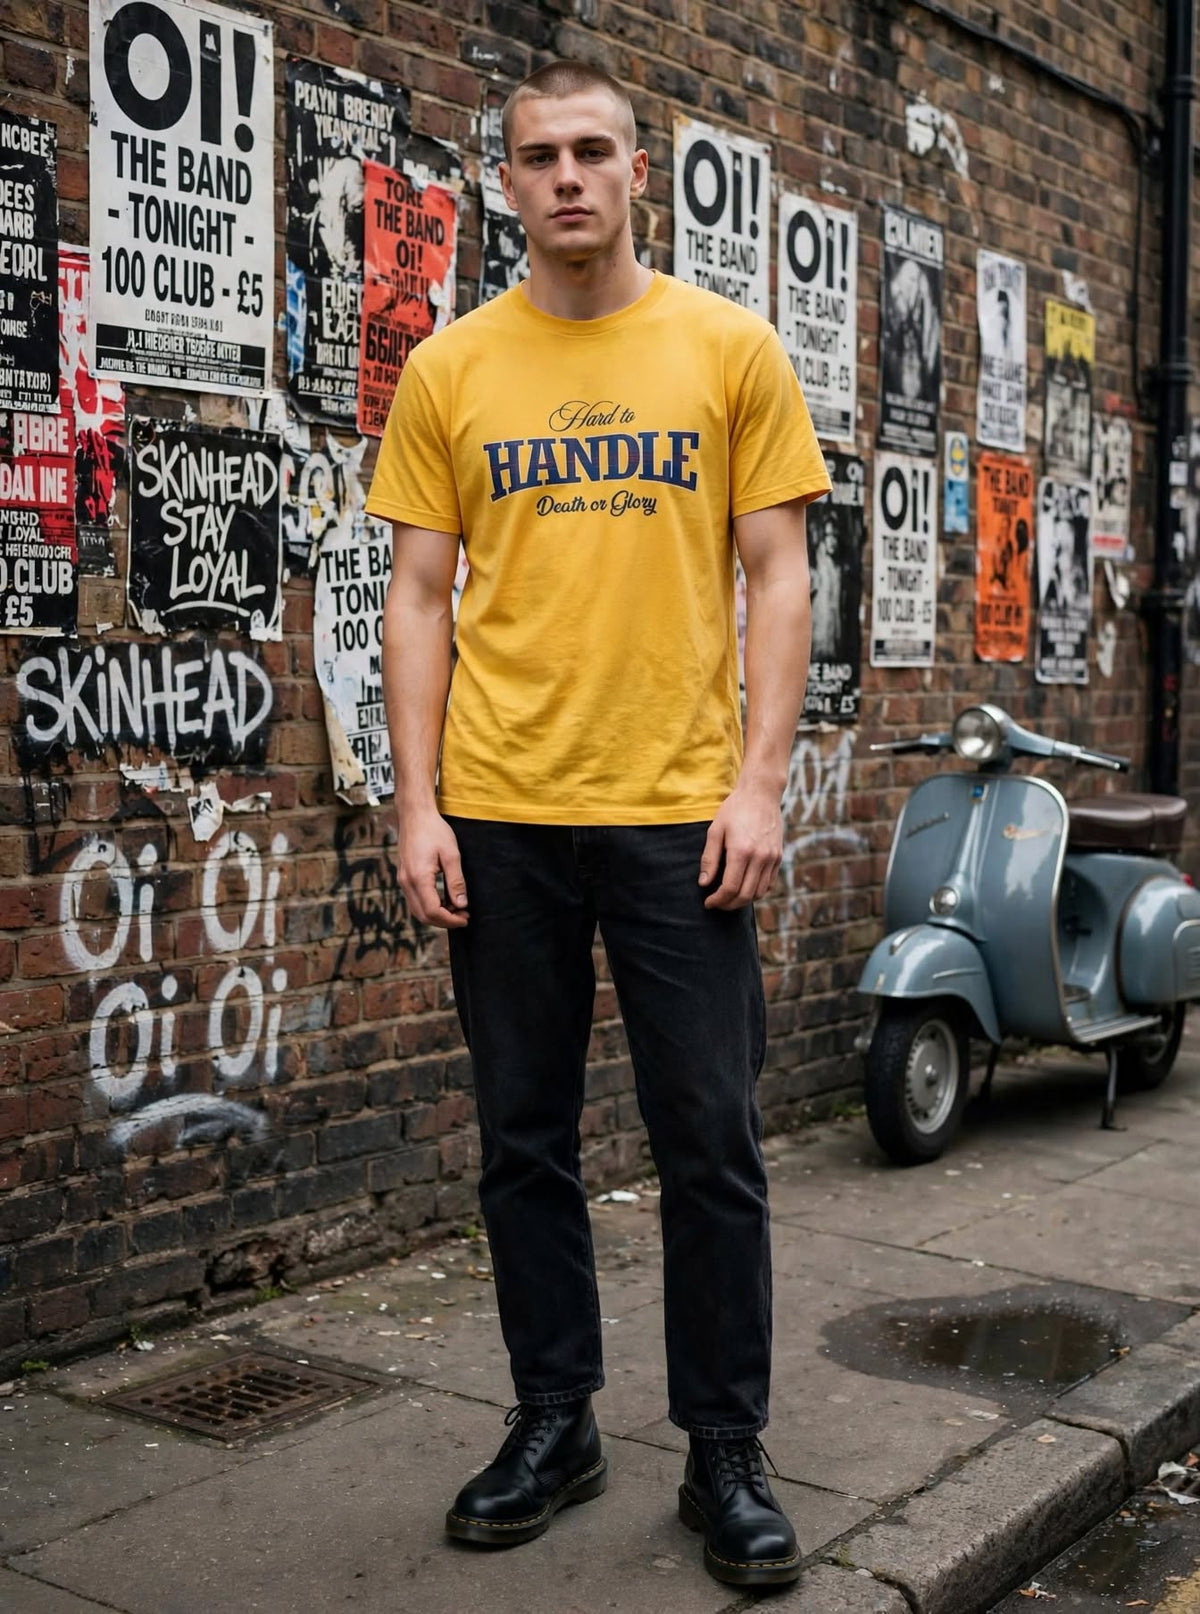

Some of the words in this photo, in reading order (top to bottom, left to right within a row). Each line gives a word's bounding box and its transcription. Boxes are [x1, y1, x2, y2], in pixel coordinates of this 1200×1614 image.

[111, 130, 167, 188] THE
[177, 145, 252, 206] BAND
[128, 191, 236, 257] TONIGHT
[374, 198, 402, 234] THE
[405, 208, 445, 246] BAND
[686, 228, 714, 266] THE
[720, 237, 758, 276] BAND
[102, 245, 146, 298] 100
[153, 254, 214, 308] CLUB
[237, 270, 263, 317] £5
[788, 285, 810, 316] THE
[816, 291, 846, 325] BAND
[548, 400, 621, 432] Hard
[620, 407, 635, 424] to
[482, 430, 700, 503] HANDLE
[536, 495, 586, 517] Death
[590, 498, 607, 511] or
[610, 490, 657, 517] Glory
[8, 525, 44, 543] LOYAL
[160, 499, 236, 553] STAY
[321, 547, 361, 583] THE
[368, 543, 392, 577] BA
[882, 535, 900, 561] THE
[903, 538, 927, 564] BAND
[14, 558, 73, 595] CLUB
[170, 549, 265, 600] LOYAL
[5, 594, 34, 627] £5
[331, 580, 392, 616] TONI
[332, 618, 368, 653] 100
